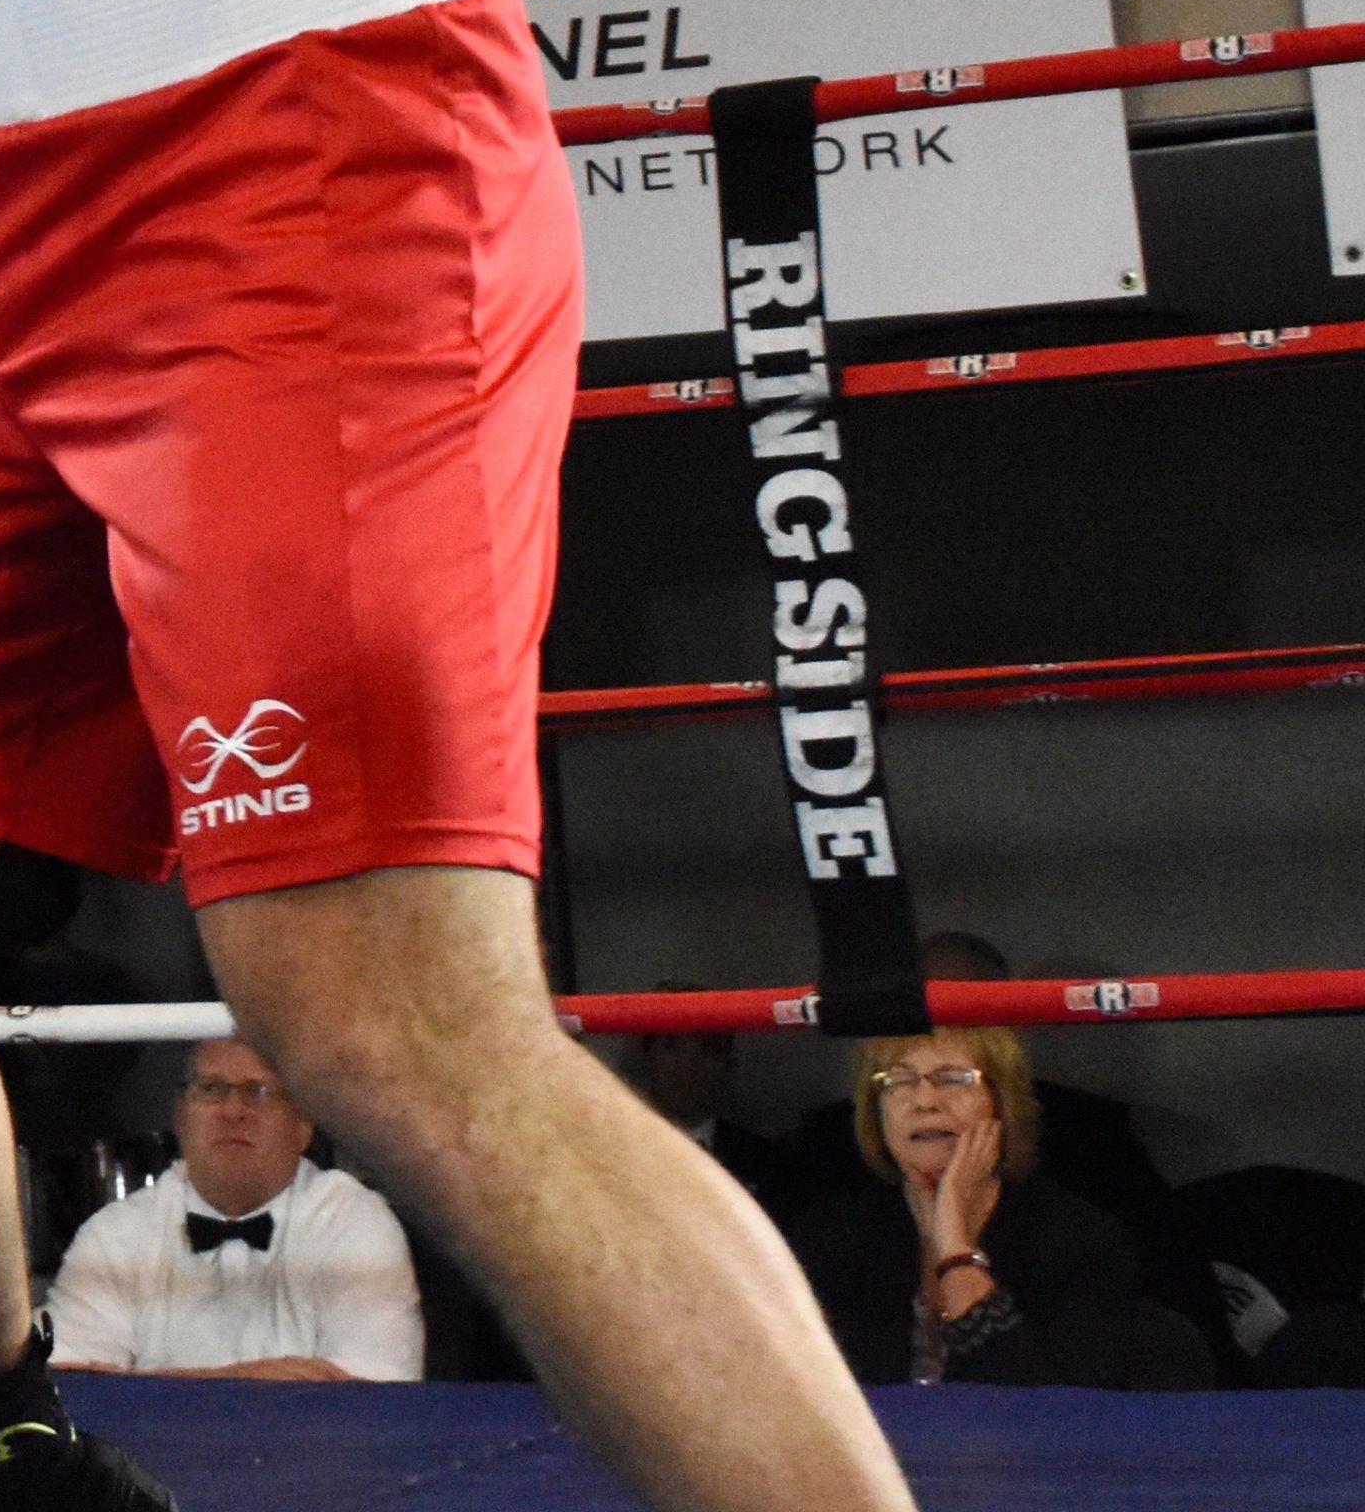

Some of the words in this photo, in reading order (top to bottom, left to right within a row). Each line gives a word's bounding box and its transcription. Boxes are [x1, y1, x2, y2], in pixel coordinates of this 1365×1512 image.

[585, 125, 955, 197] NETORK
[727, 230, 898, 881] RINGSIDE
[180, 783, 311, 836] STING
